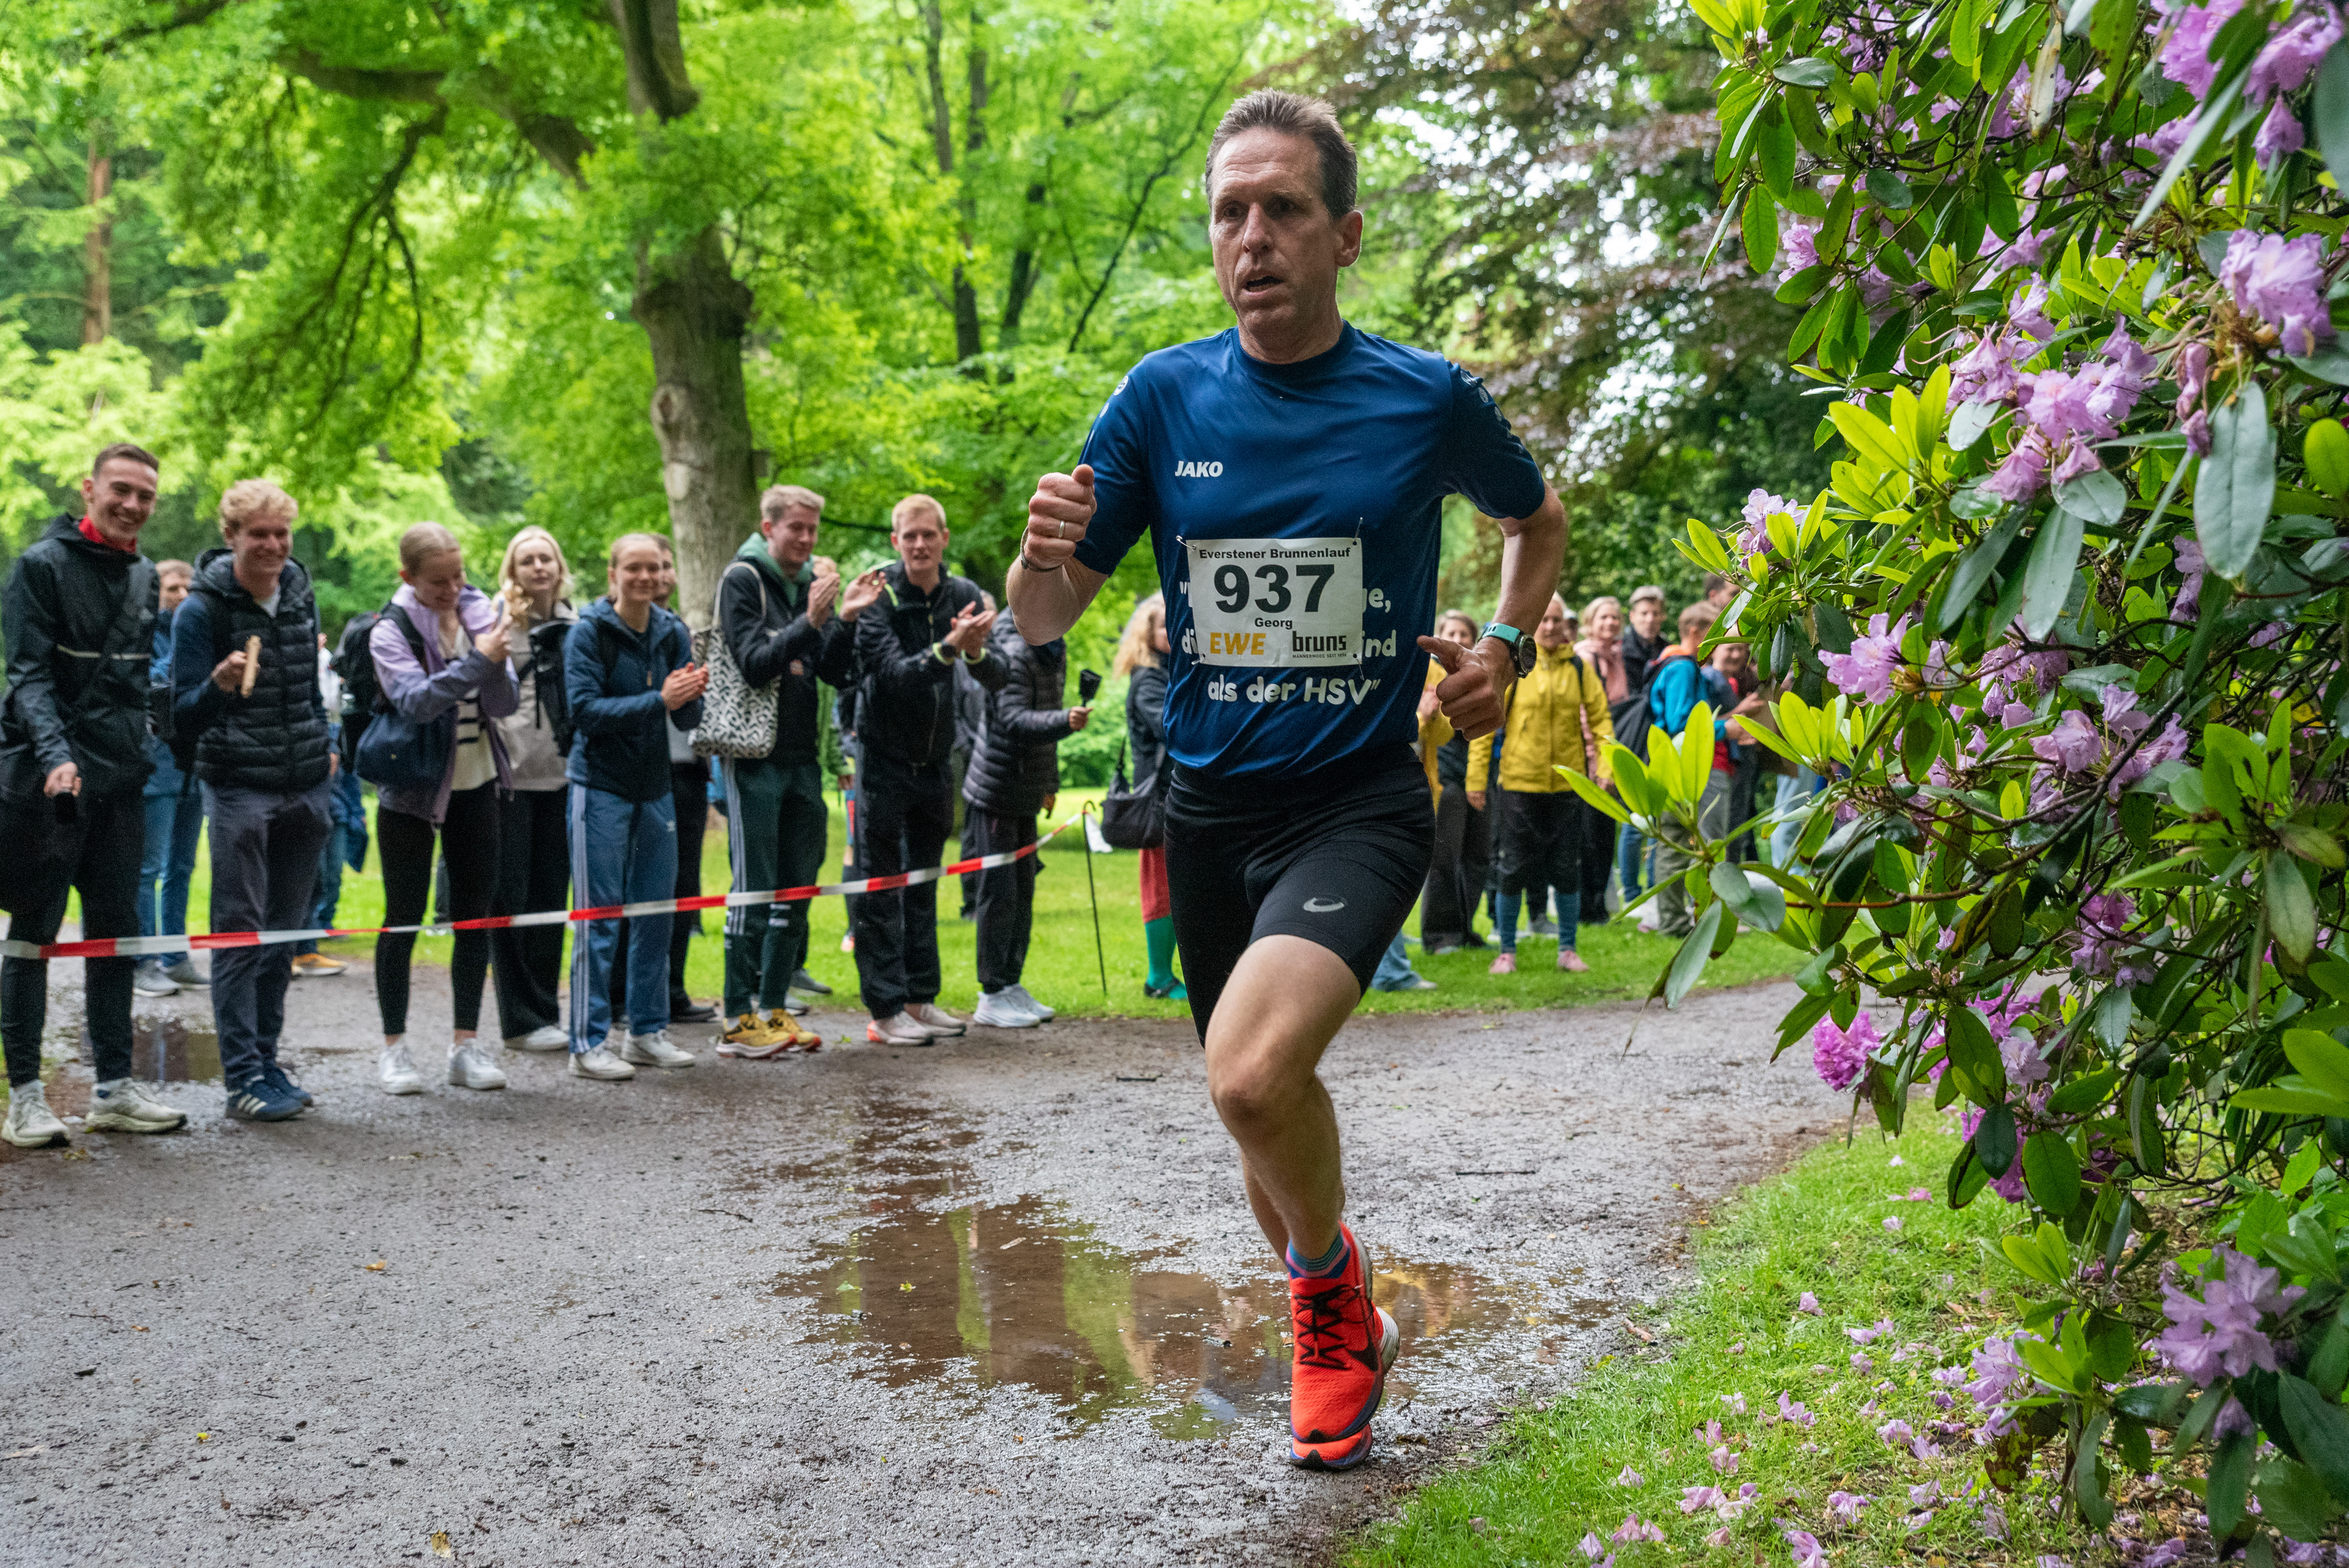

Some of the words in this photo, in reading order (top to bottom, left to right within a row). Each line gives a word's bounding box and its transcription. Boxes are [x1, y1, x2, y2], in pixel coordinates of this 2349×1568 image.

[1174, 460, 1223, 477] JAKO
[1199, 549, 1266, 559] Everstener
[1270, 548, 1350, 558] Brunnenlauf
[1214, 564, 1335, 613] 937
[1254, 617, 1292, 629] Georg
[1209, 632, 1266, 655] EWE
[1292, 631, 1346, 651] bruns
[1208, 674, 1238, 703] als
[1246, 676, 1297, 703] der
